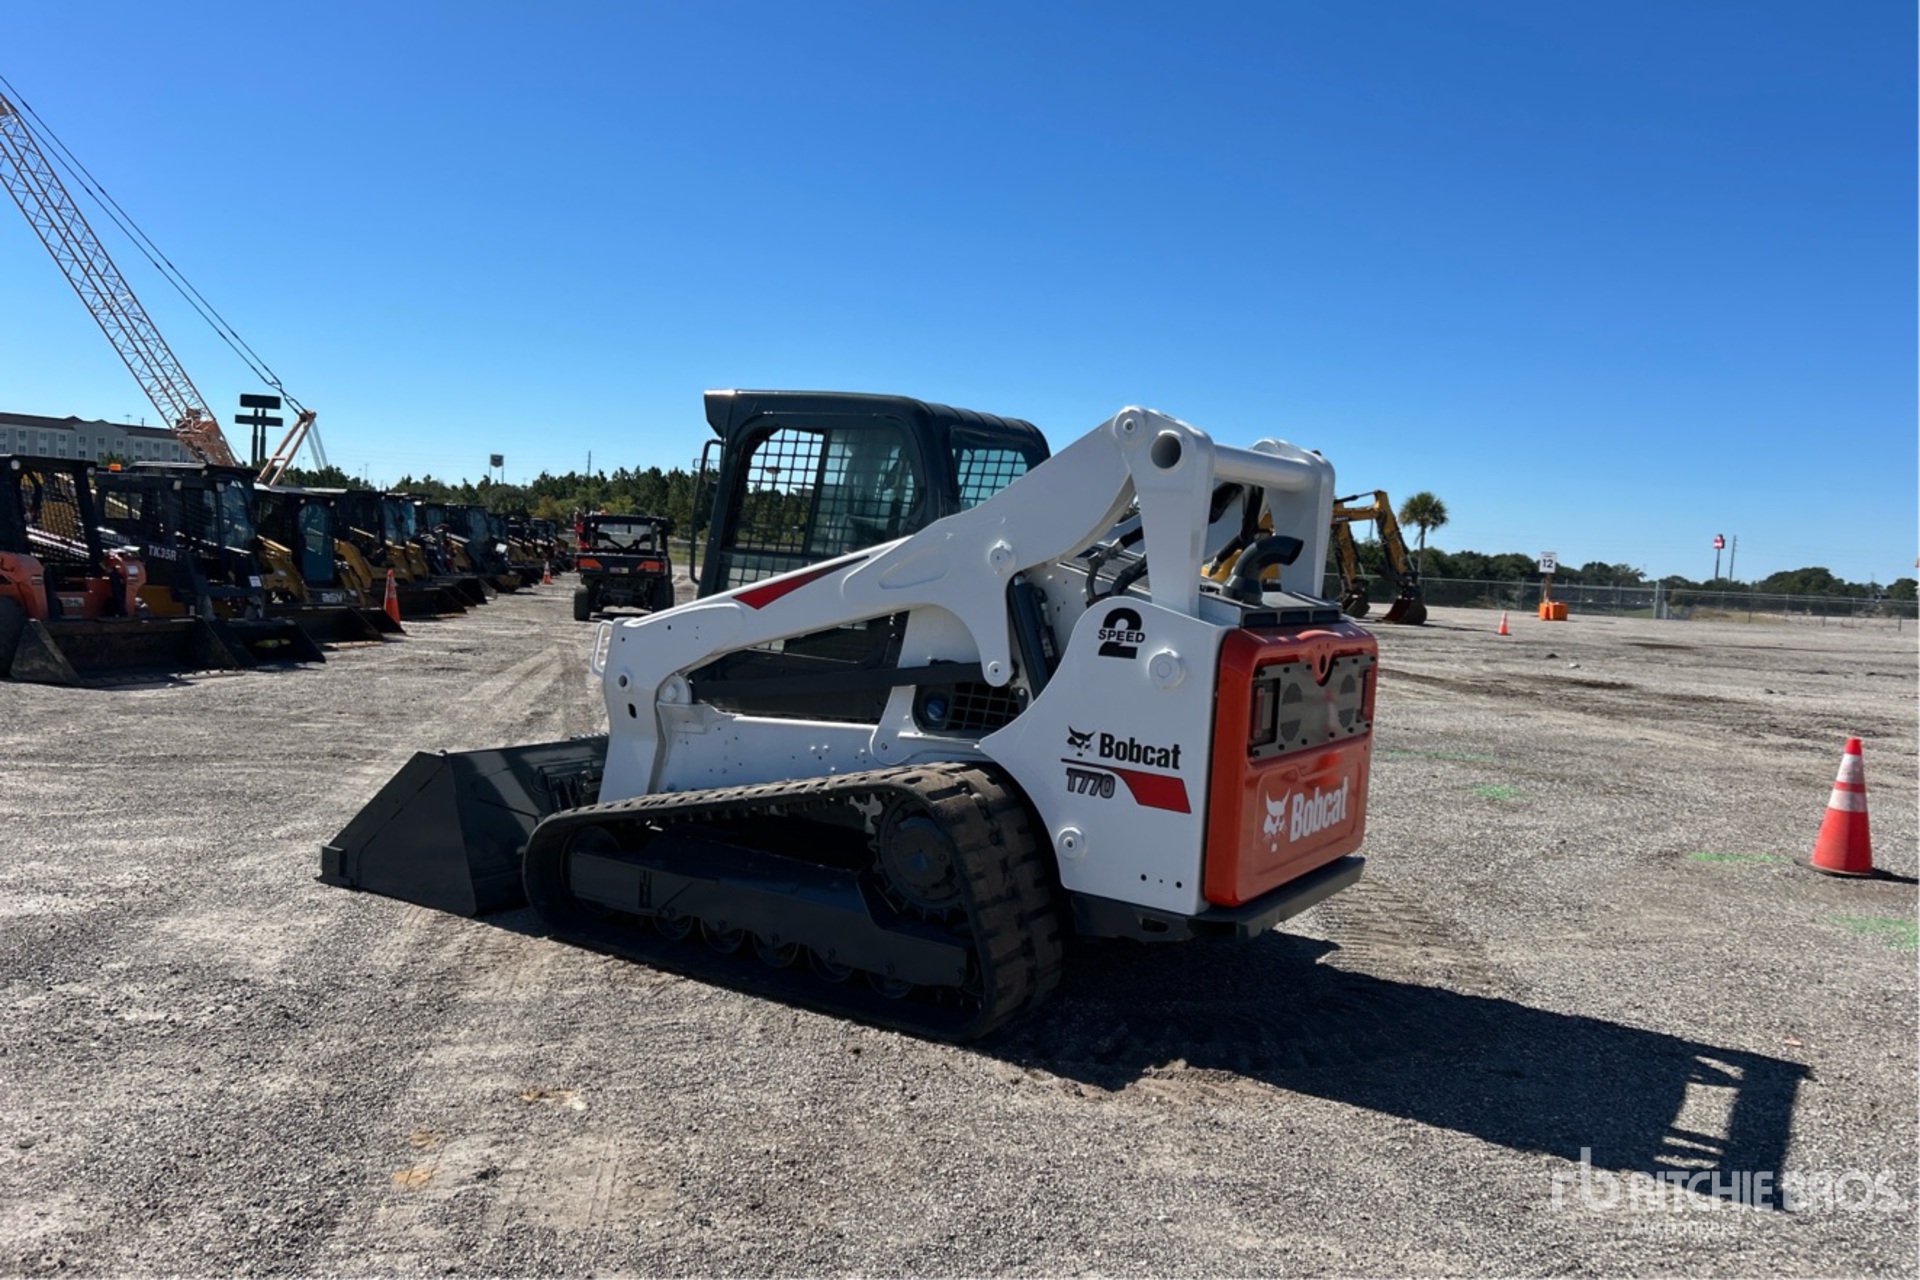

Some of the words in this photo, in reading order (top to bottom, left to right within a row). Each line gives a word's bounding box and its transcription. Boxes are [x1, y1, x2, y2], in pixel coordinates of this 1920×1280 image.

[148, 545, 177, 562] TK35R
[1542, 558, 1554, 569] 12
[1097, 628, 1146, 644] SPEED
[1098, 607, 1143, 659] 2
[1099, 733, 1181, 769] Bobcat
[1066, 768, 1116, 799] T770
[1289, 776, 1349, 842] Bobcat
